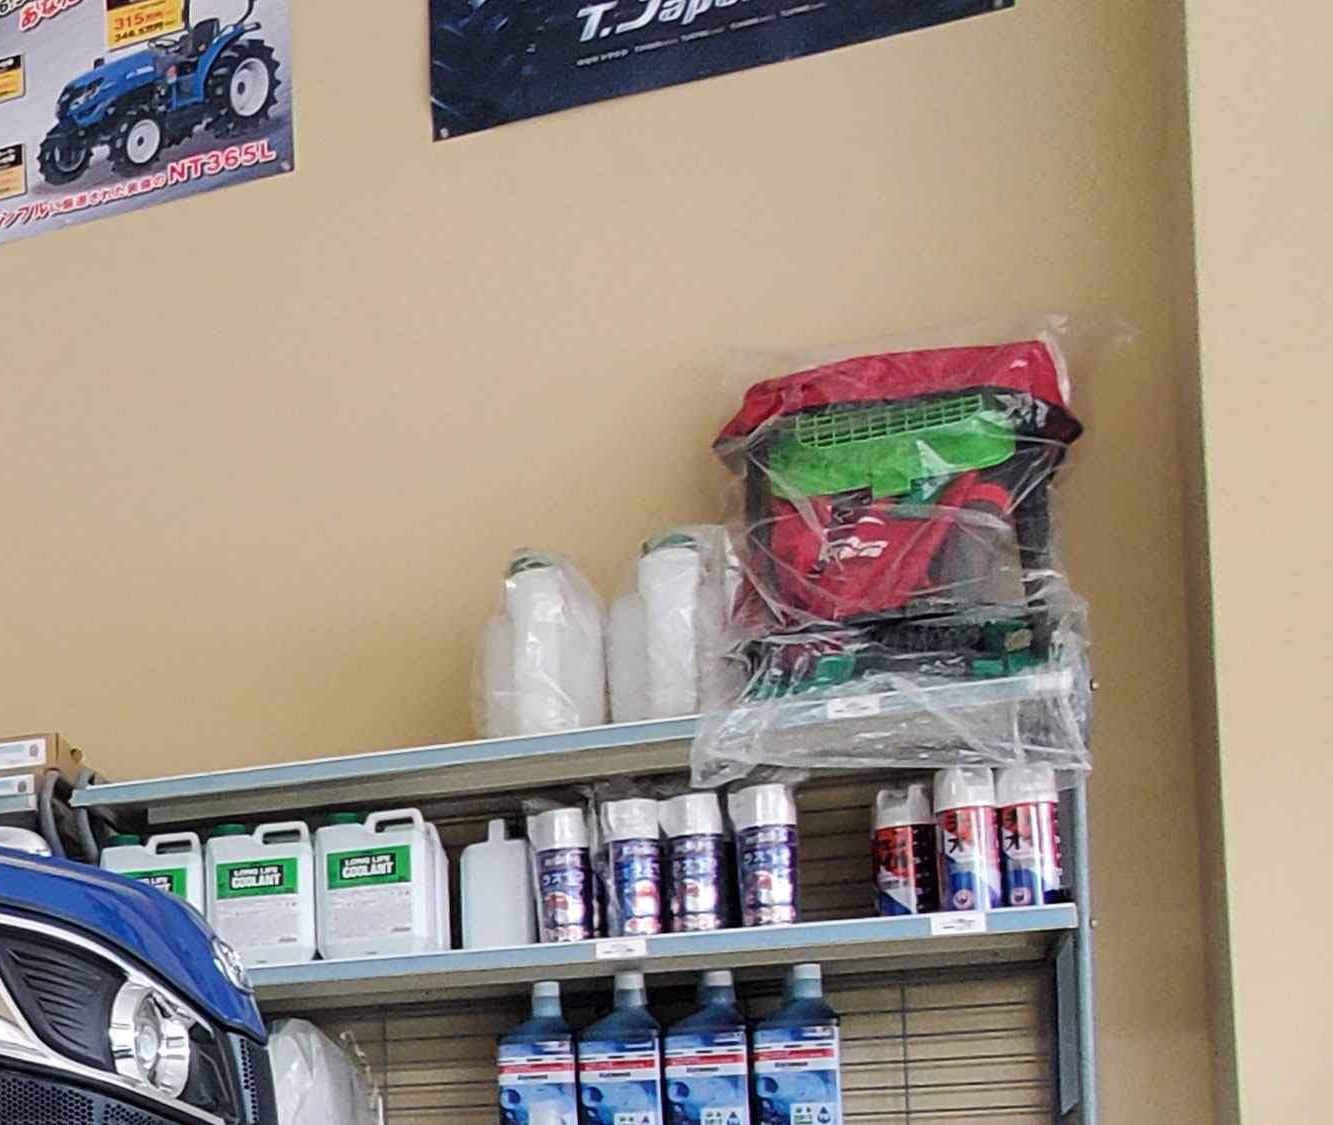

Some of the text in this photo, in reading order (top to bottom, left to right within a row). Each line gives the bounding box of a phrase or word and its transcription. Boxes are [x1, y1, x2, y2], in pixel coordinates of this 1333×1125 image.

[167, 140, 277, 185] NT365L
[341, 861, 395, 879] COOLANT
[231, 873, 282, 889] COOLANT
